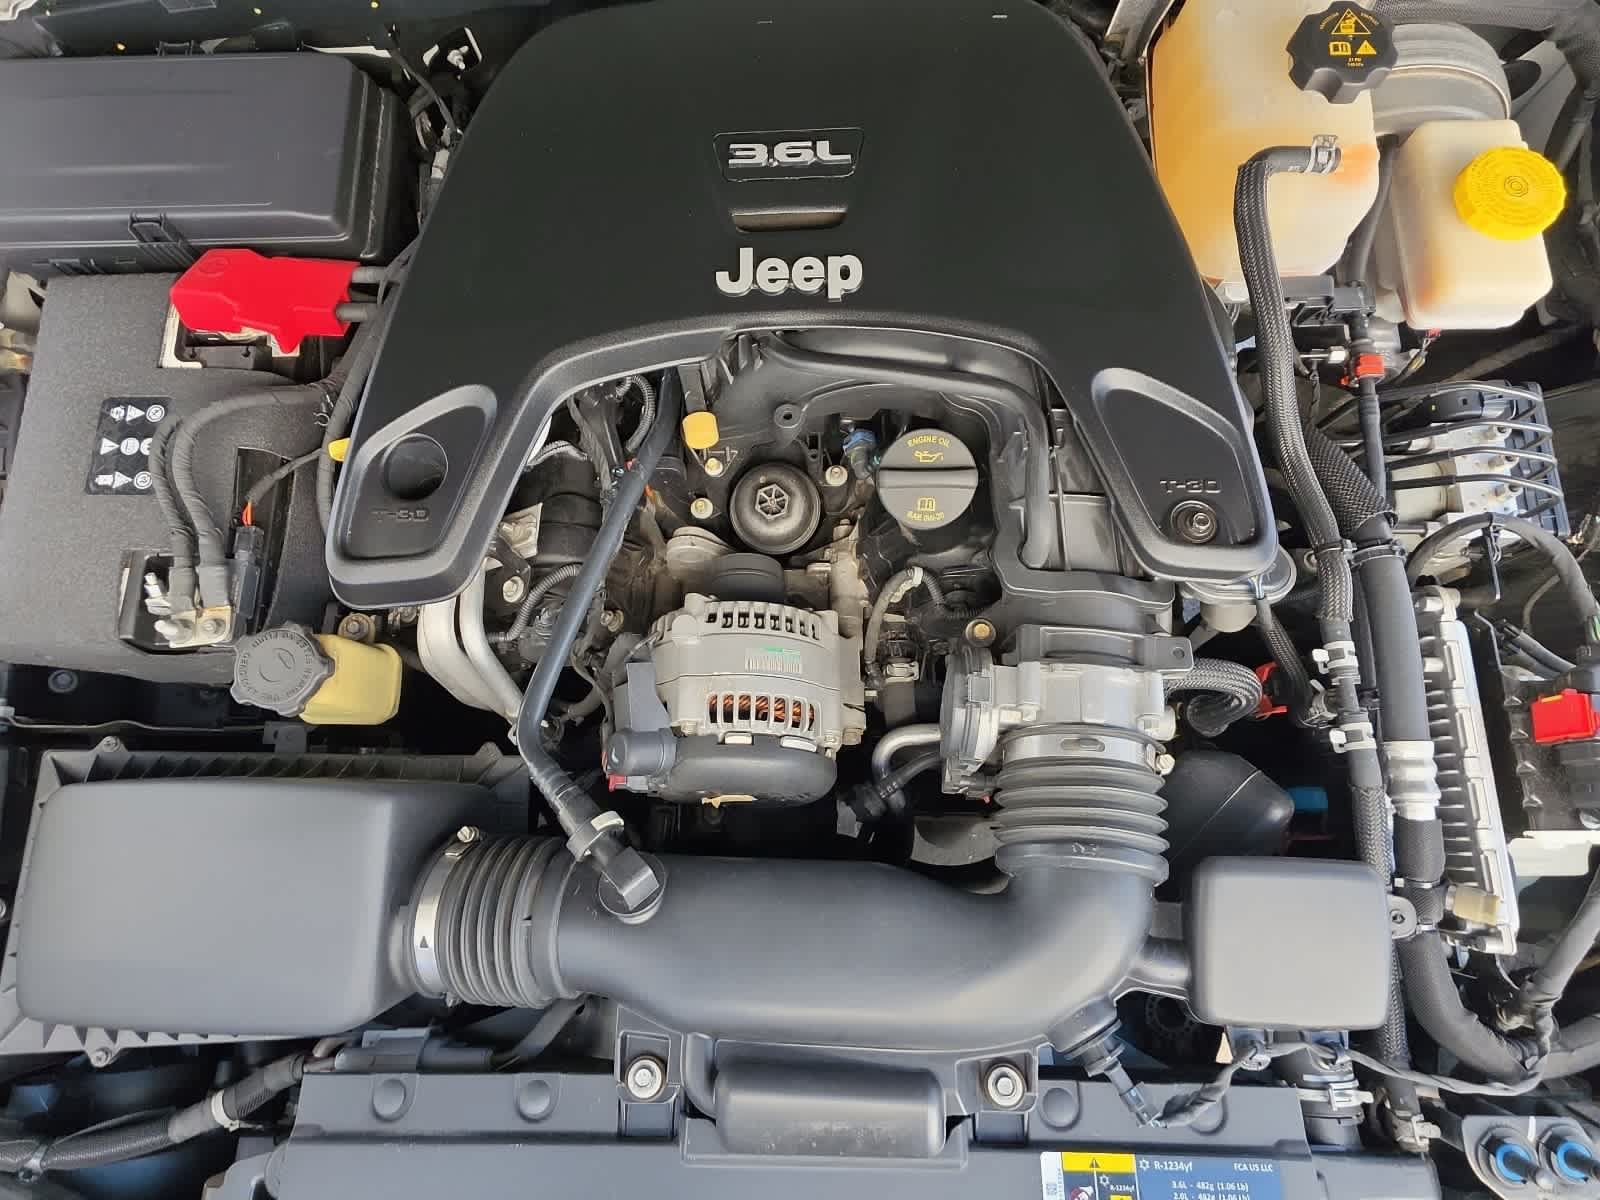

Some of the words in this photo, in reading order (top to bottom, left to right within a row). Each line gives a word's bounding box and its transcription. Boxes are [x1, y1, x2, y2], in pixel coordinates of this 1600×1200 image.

[728, 140, 852, 168] 3.6L
[715, 247, 864, 302] Jeep
[907, 435, 938, 448] ENGINE
[938, 438, 951, 448] OIL
[1160, 480, 1222, 493] T-30
[1233, 1163, 1249, 1172] FCA
[1249, 1164, 1260, 1172] US
